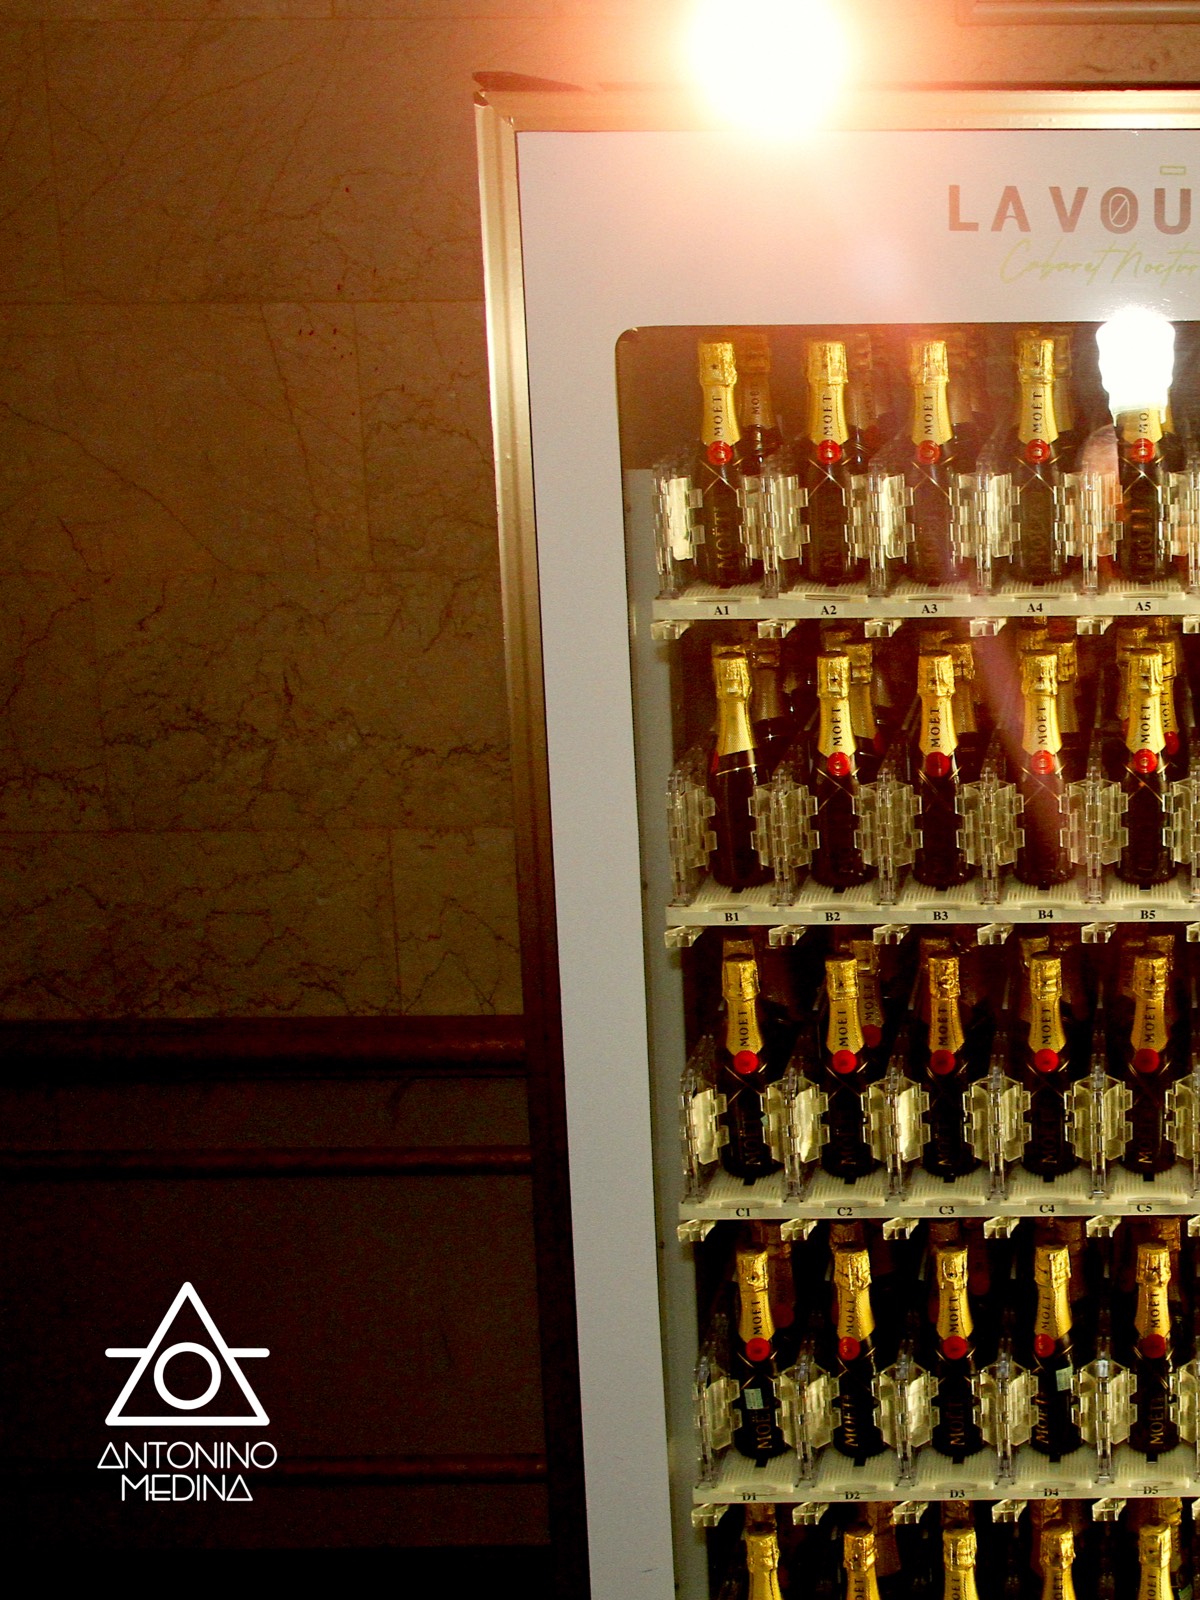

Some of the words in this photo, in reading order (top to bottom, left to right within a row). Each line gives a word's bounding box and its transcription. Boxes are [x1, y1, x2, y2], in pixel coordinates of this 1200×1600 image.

[714, 606, 729, 616] A1
[821, 606, 837, 616] A2
[921, 604, 938, 615] A3
[1027, 603, 1043, 613] A4
[1135, 602, 1151, 612] A5
[725, 912, 739, 922] B1
[825, 912, 840, 922] B2
[933, 911, 948, 921] B3
[1038, 910, 1053, 920] B4
[1141, 910, 1155, 920] B5
[736, 1208, 750, 1218] C1
[837, 1207, 852, 1217] C2
[939, 1206, 955, 1215] C3
[1040, 1204, 1055, 1214] C4
[1137, 1204, 1152, 1213] C5
[950, 1490, 965, 1499] D3
[1044, 1488, 1059, 1497] D4
[1144, 1486, 1158, 1495] D5
[742, 1493, 756, 1502] D1
[845, 1491, 860, 1501] D2
